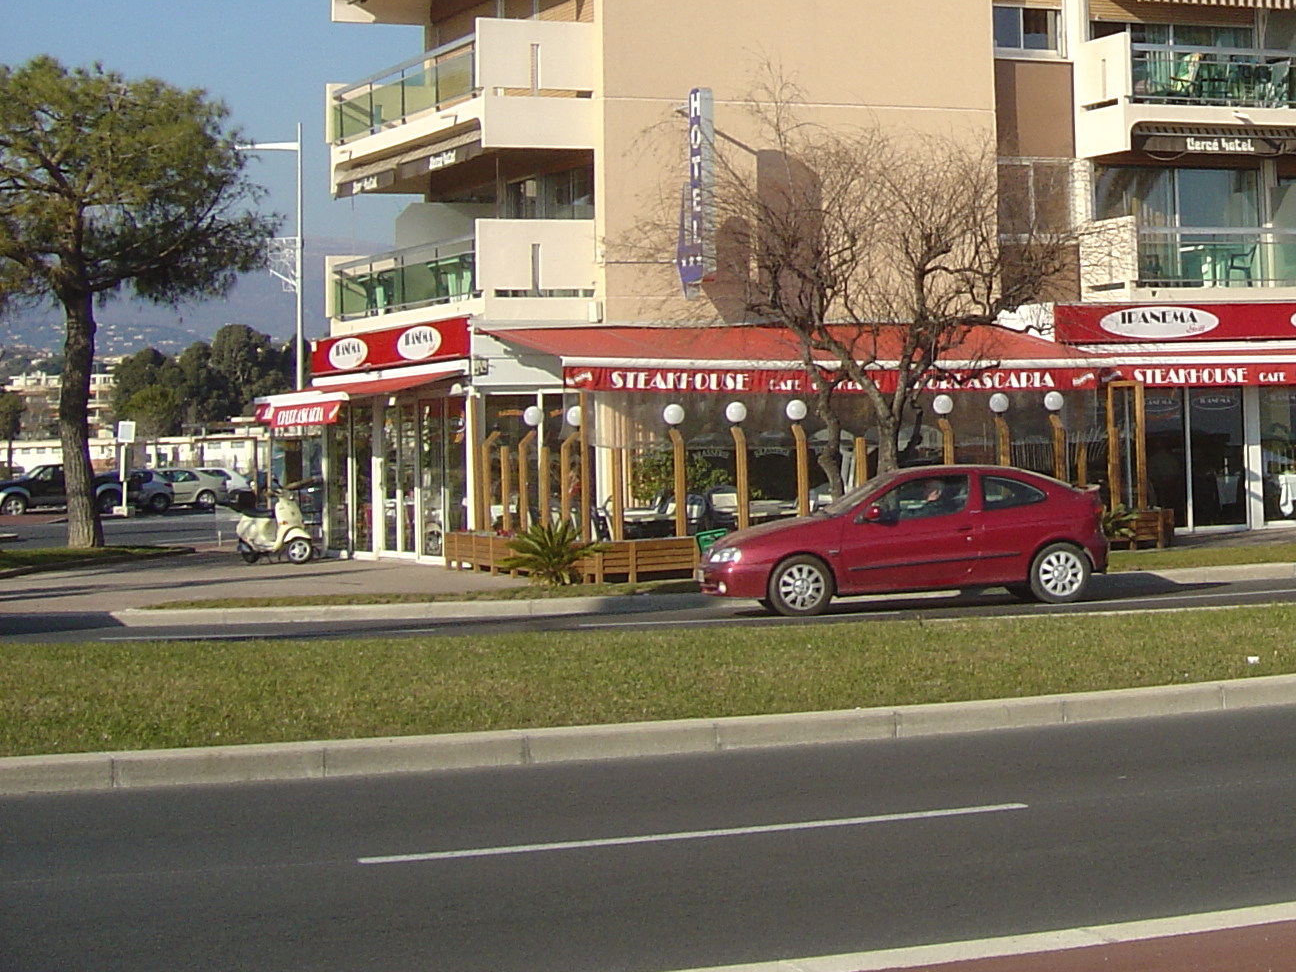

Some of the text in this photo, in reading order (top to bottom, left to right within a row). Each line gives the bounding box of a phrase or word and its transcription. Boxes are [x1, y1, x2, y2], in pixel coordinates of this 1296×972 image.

[690, 92, 701, 244] HOTEL
[1120, 311, 1198, 325] IPANEMA
[611, 371, 750, 391] STEAKHOUSE
[1133, 367, 1248, 384] STEAKHOUSE
[1259, 372, 1286, 382] CAFE
